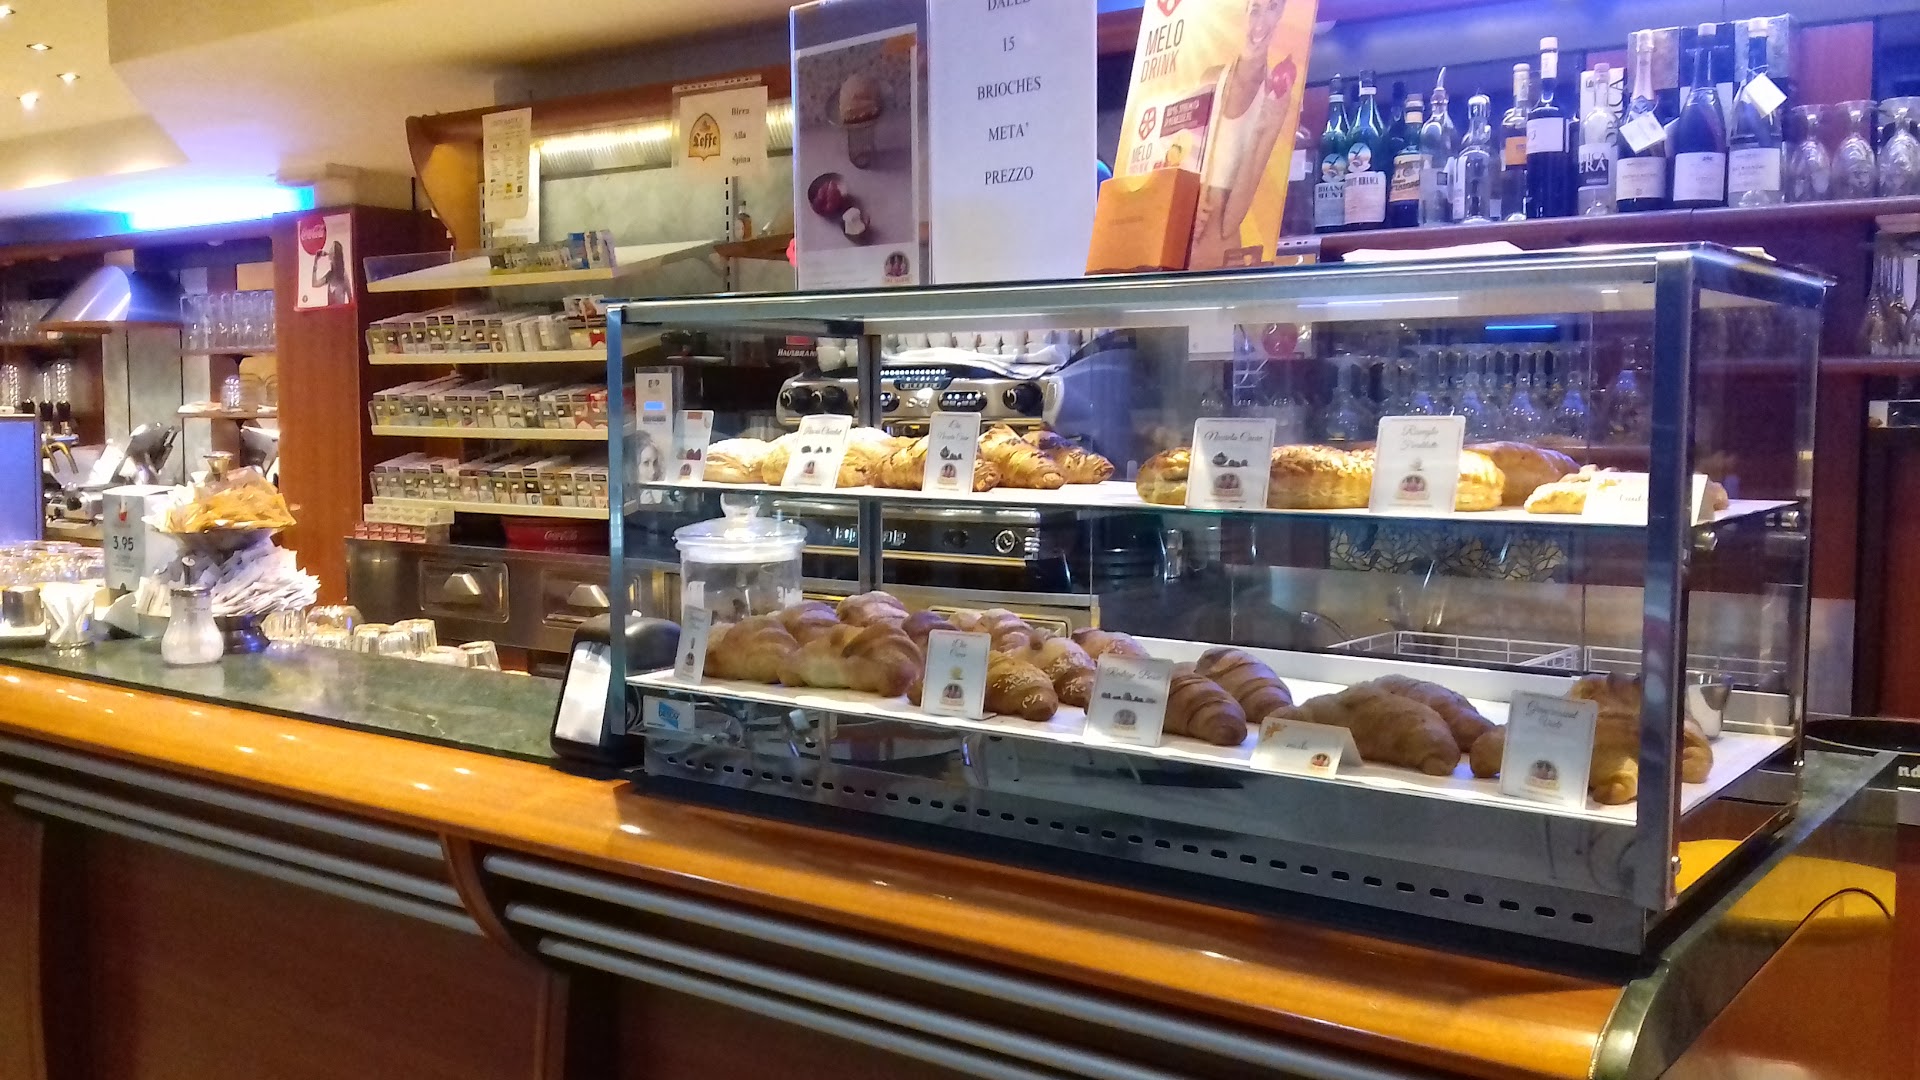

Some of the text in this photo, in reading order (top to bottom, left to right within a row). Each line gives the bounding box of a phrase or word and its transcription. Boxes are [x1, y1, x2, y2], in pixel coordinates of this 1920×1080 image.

[1003, 36, 1015, 52] 15
[1145, 19, 1184, 57] MELO
[1140, 49, 1179, 83] DRINK
[977, 76, 1042, 101] BRIOCHES
[731, 107, 750, 116] Birra
[693, 132, 718, 149] Leffe
[988, 122, 1029, 142] META'
[731, 156, 751, 166] Spina
[985, 166, 1034, 185] PREZZO
